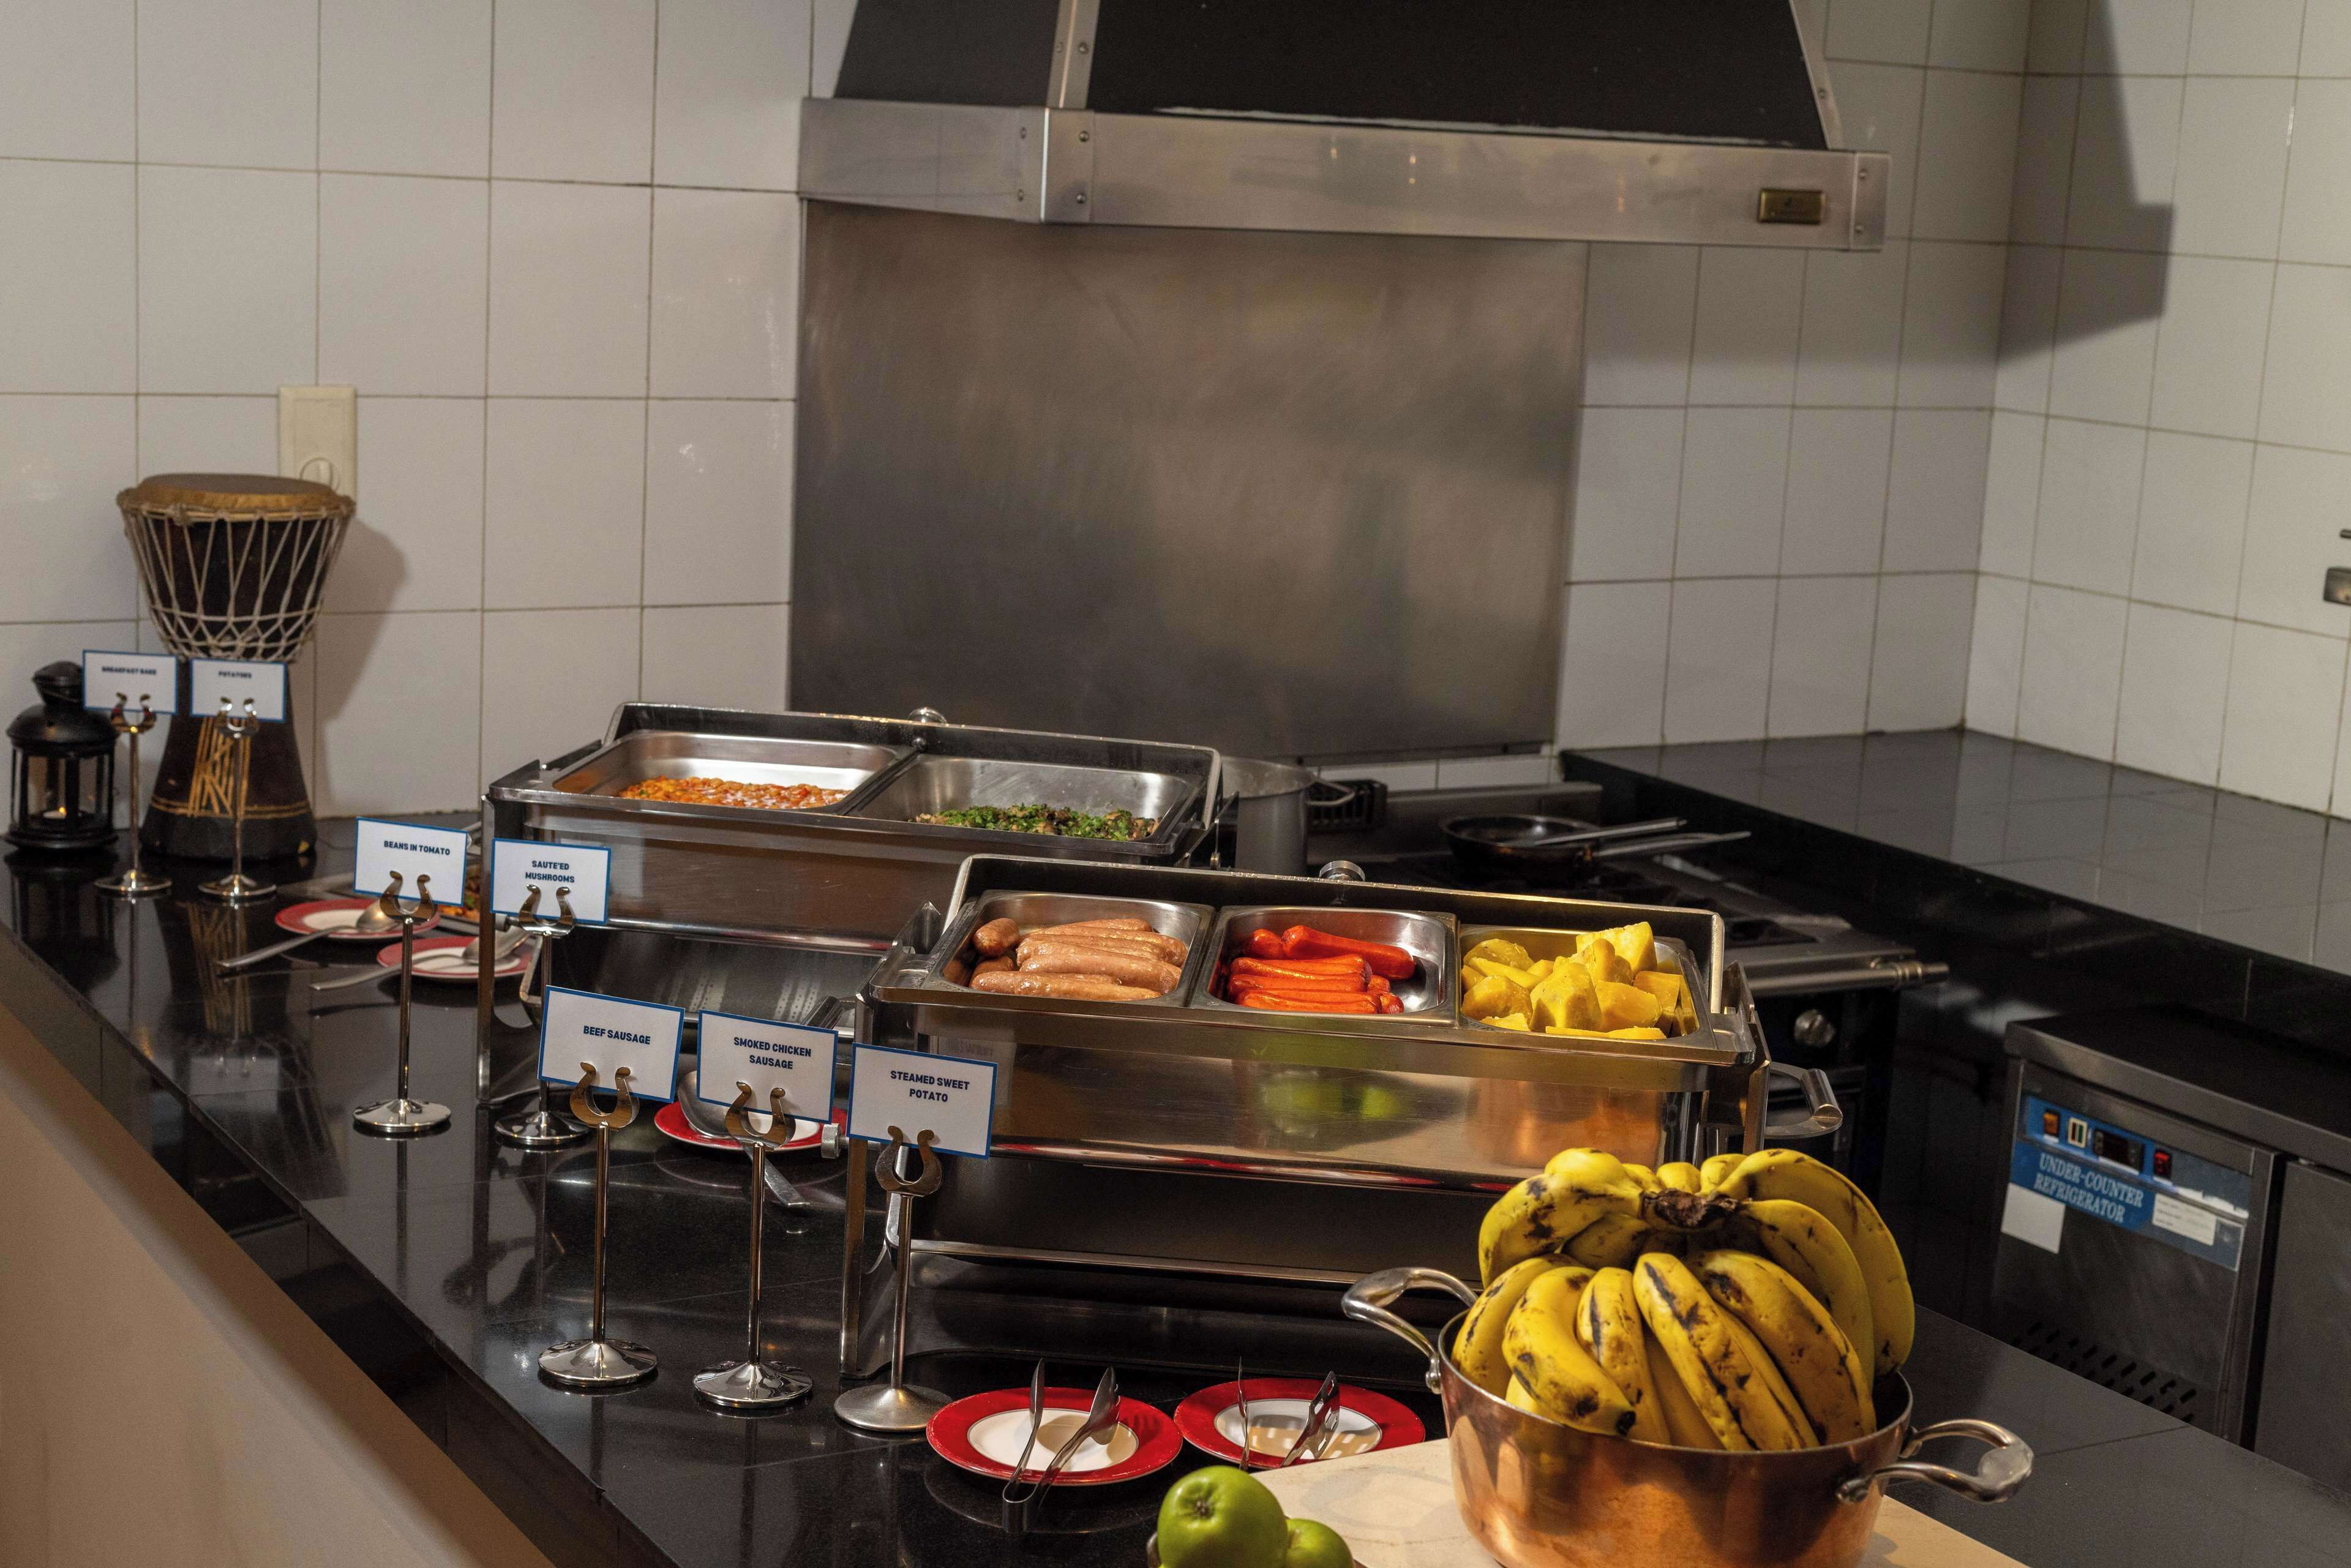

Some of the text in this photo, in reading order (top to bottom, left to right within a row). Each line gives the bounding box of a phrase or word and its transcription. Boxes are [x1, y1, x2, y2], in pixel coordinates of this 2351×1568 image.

[384, 840, 409, 850] BEANS
[419, 845, 451, 855] TOMATO
[531, 860, 569, 870] SAUTE'ED
[525, 872, 575, 883] MUSHROOMS
[583, 1025, 651, 1045] BEEF SAUSAGE
[733, 1037, 812, 1057] SMOKED CHICKEN
[749, 1054, 793, 1070] SAUSAGE
[890, 1070, 970, 1090] STEAMED SWEET
[909, 1088, 948, 1103] POTATO
[2039, 1152, 2144, 1208] UNDER-COUNTER
[2033, 1172, 2126, 1224] REFRIGERATOR
